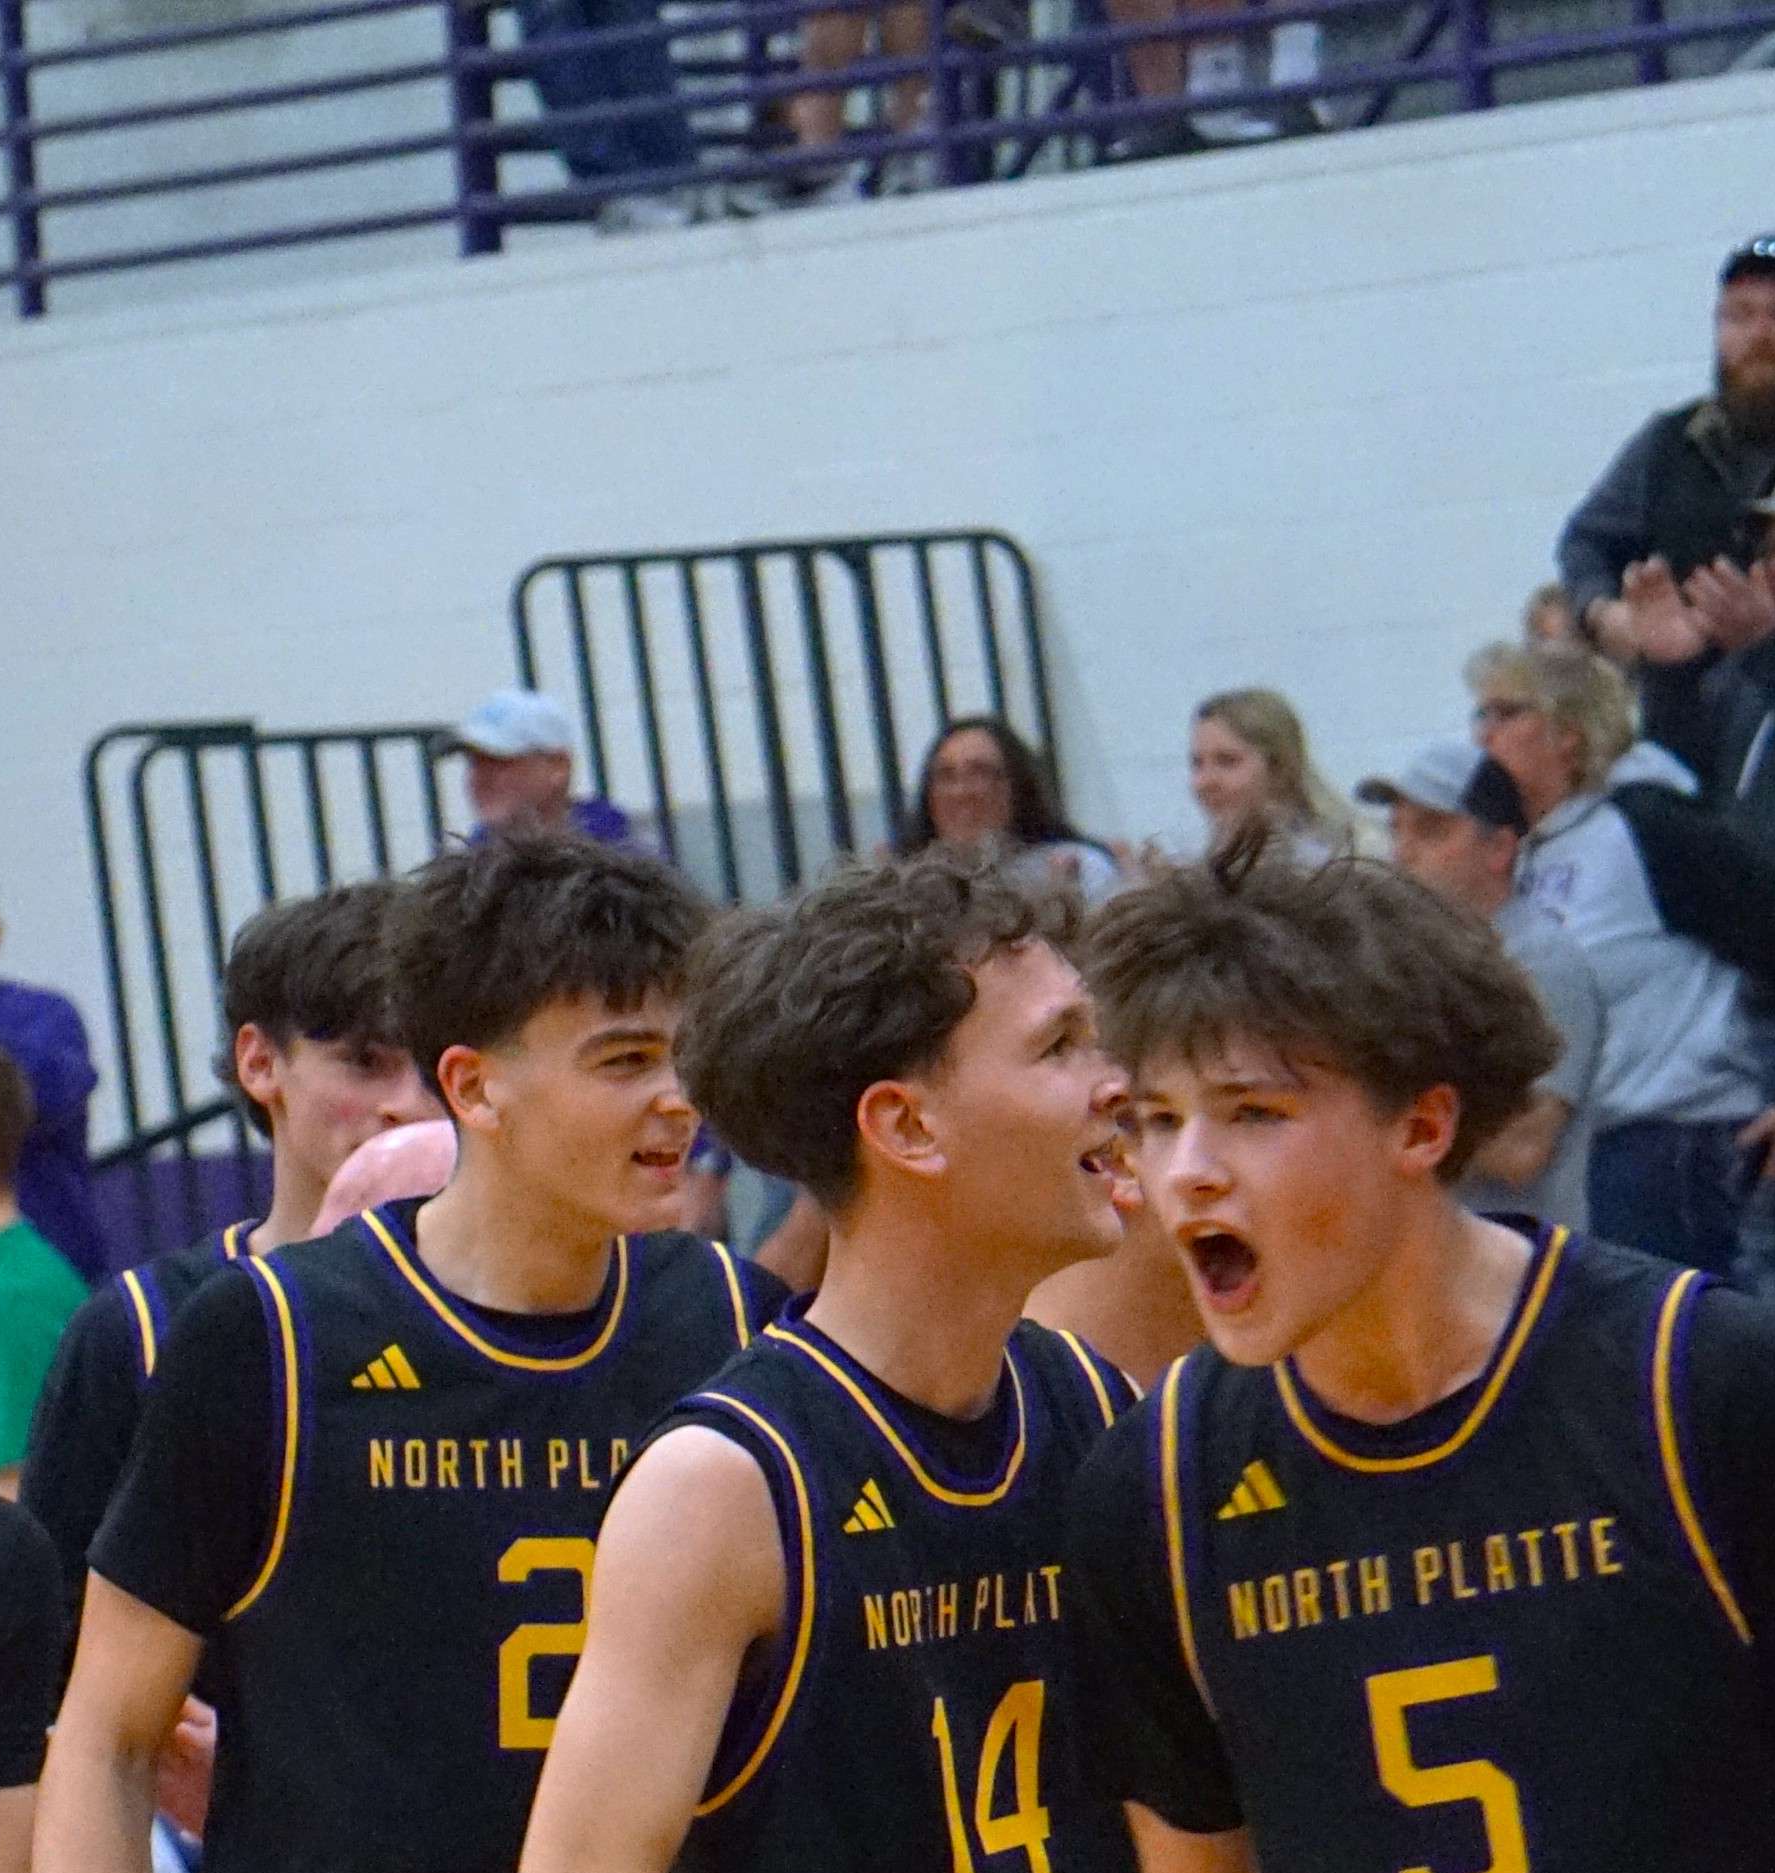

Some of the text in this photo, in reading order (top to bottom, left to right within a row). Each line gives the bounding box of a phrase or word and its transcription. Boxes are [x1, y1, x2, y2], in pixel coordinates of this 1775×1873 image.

[369, 1438, 523, 1489] NORTH
[1228, 1517, 1623, 1640] NORTH PLATTE
[497, 1536, 597, 1750] 2
